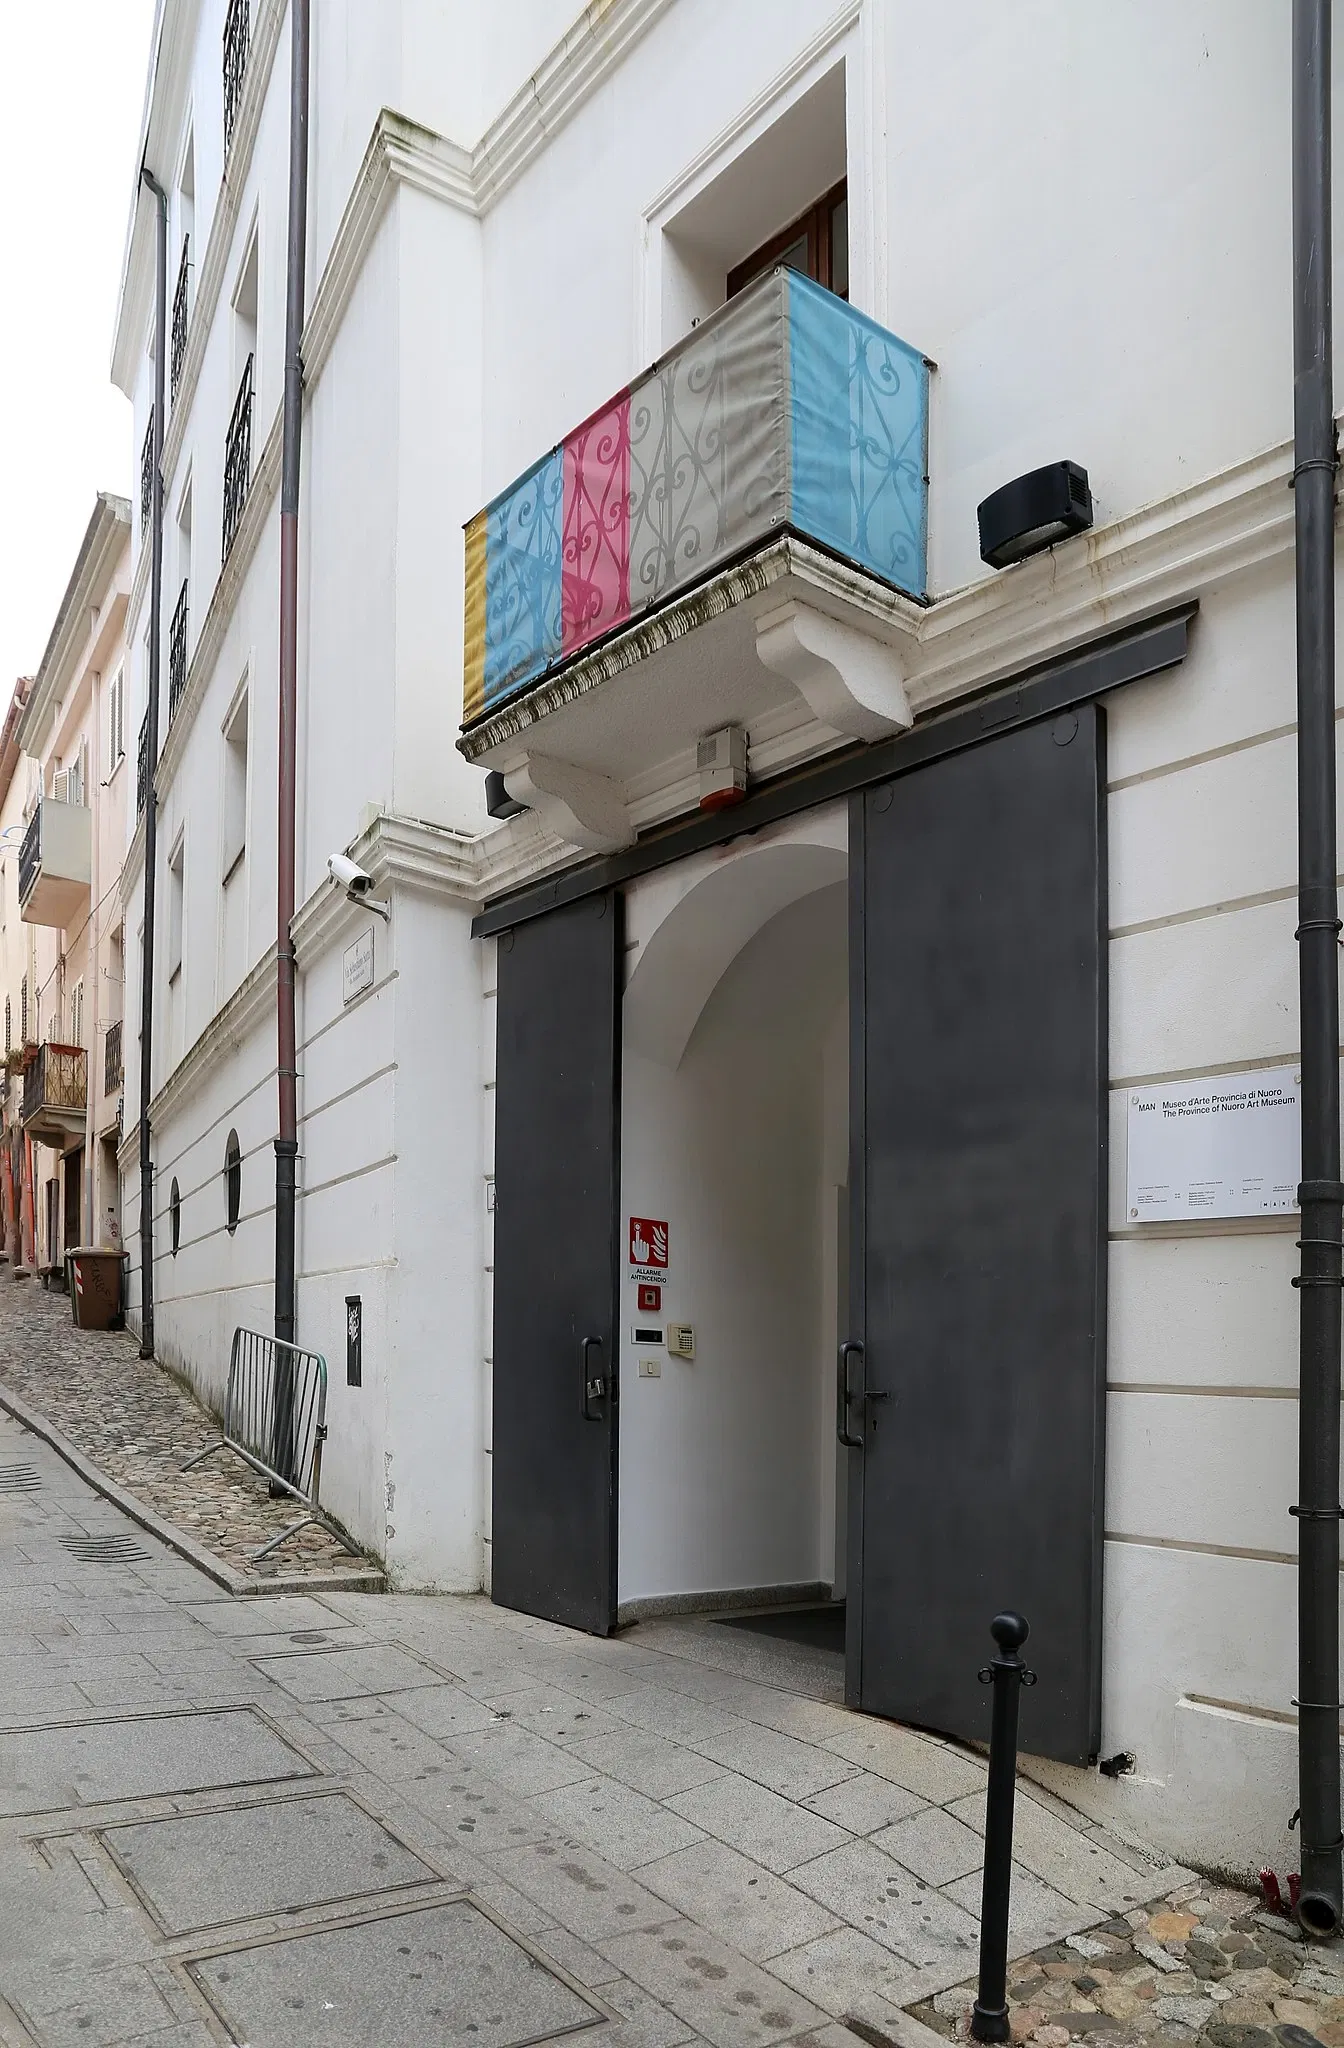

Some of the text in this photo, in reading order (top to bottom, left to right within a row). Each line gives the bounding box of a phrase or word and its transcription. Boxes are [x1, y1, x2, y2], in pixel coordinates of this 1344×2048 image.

[1138, 1089, 1282, 1112] MAN Museo d'Arte Provincia di Nuoro
[1163, 1097, 1295, 1118] The Province of Nuoro Art Museum
[630, 1274, 667, 1283] ANTINCENDIO
[636, 1268, 662, 1276] ALLARME
